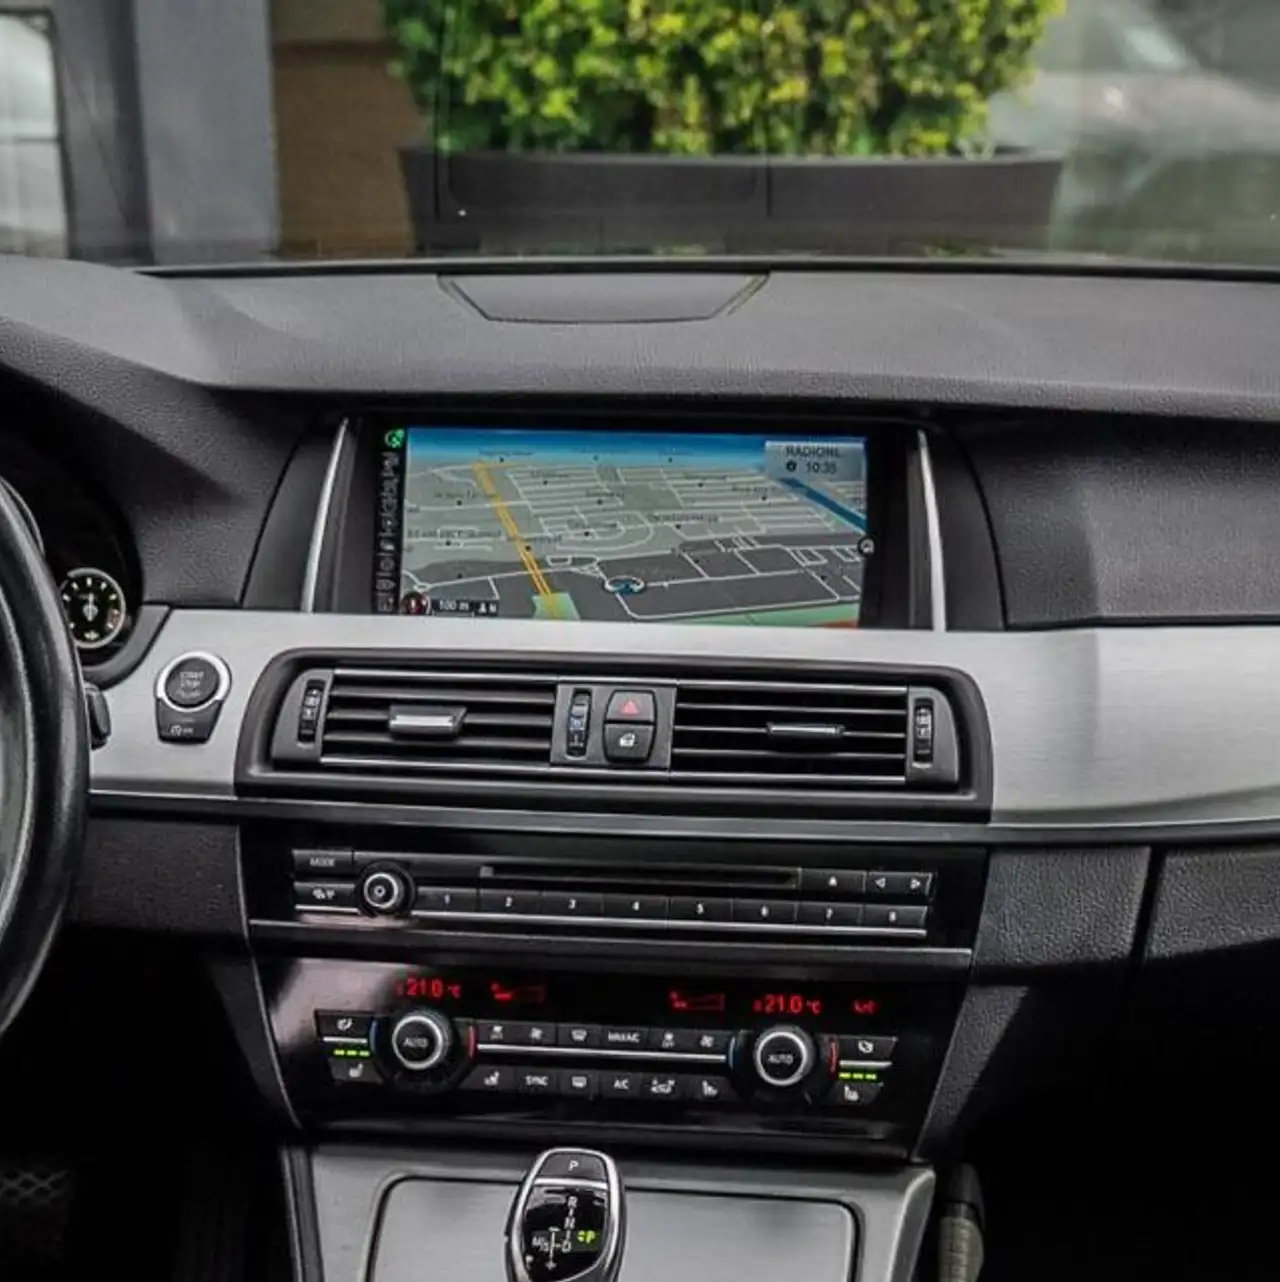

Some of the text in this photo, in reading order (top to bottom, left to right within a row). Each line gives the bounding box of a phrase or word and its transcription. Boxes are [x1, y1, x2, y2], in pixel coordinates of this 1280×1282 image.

[403, 1037, 429, 1049] AUTO
[767, 1053, 794, 1065] AUTO
[568, 1160, 579, 1172] P
